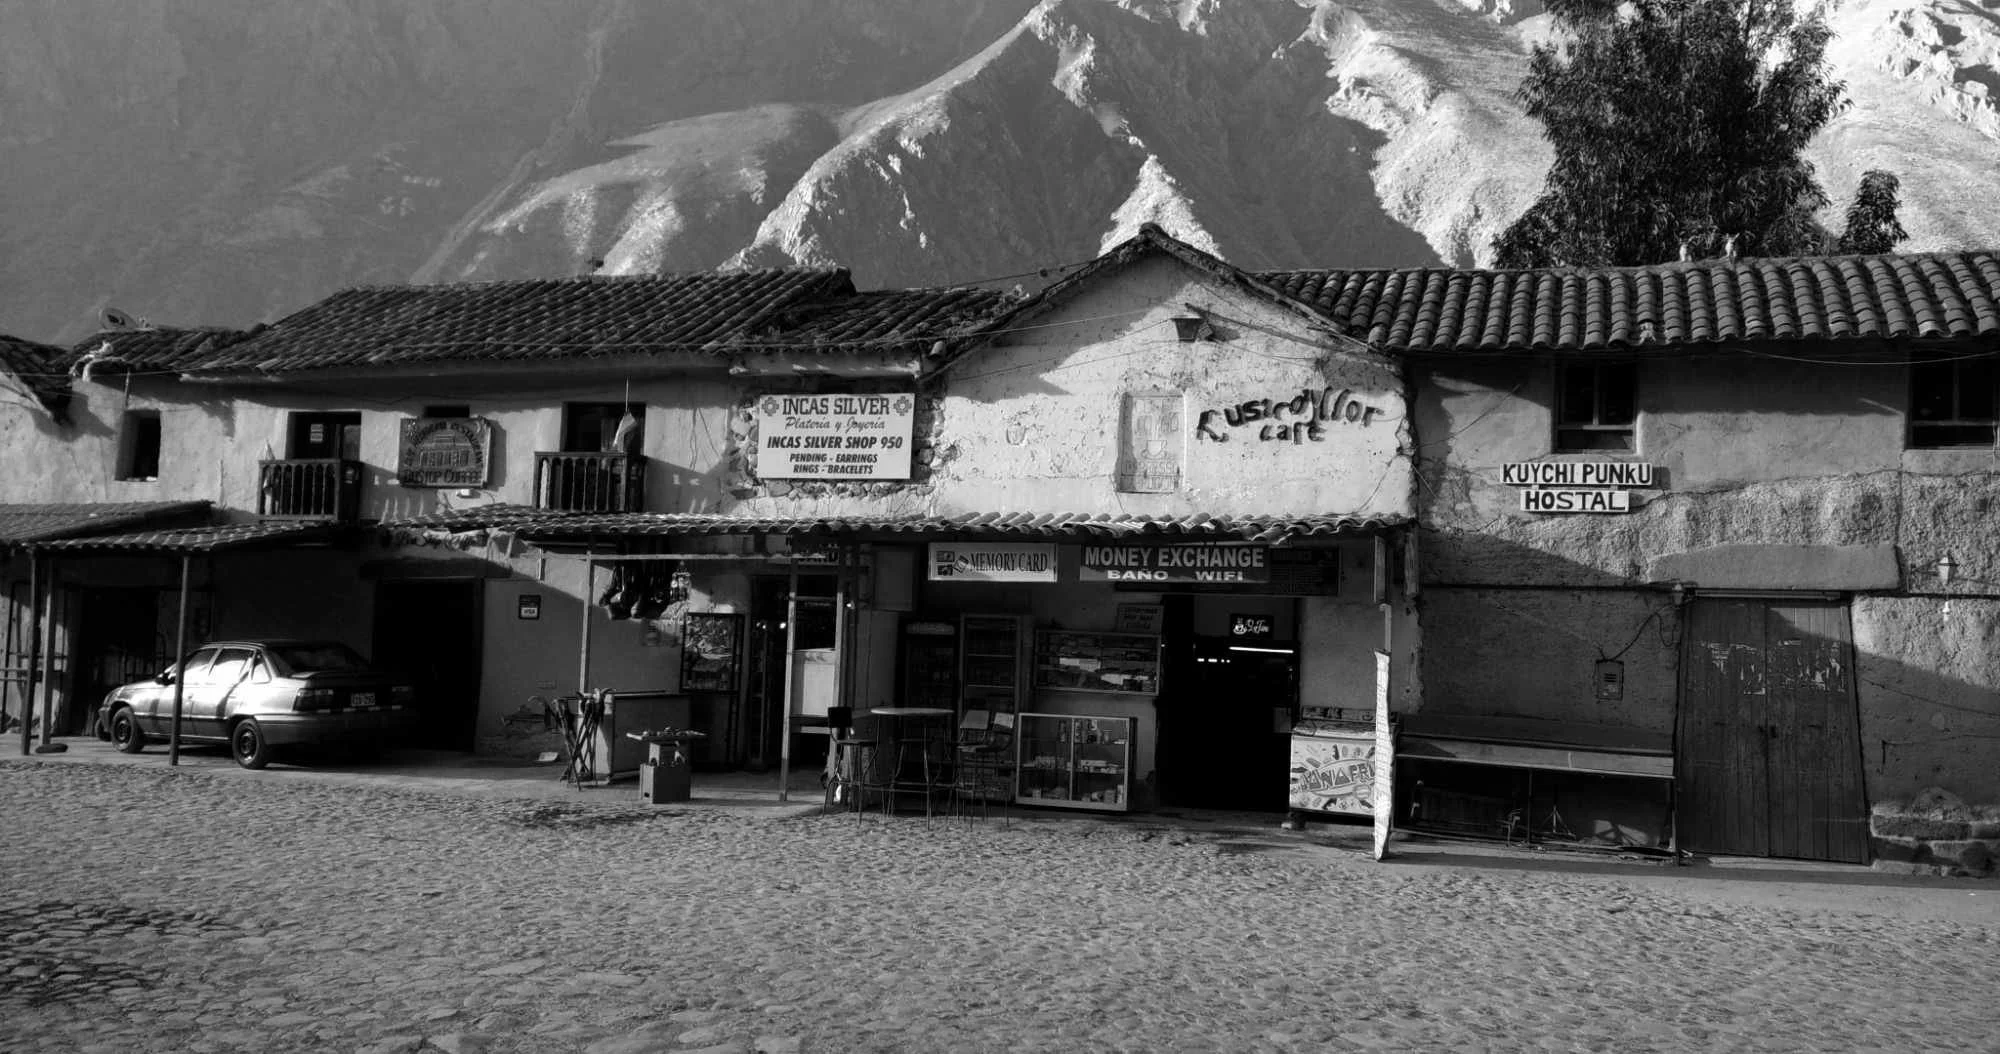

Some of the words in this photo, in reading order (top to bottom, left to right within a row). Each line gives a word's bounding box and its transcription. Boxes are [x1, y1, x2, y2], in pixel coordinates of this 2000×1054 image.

[782, 397, 829, 415] INCAS
[833, 397, 890, 415] SILVER
[834, 421, 843, 433] y
[767, 436, 801, 449] INCAS
[804, 436, 842, 449] SILVER
[845, 436, 877, 449] SHOP
[881, 436, 903, 449] 950
[790, 453, 827, 463] PENDING
[835, 453, 878, 463] EARRINGS
[793, 464, 819, 474] RINGS
[827, 465, 873, 474] BRACELETS
[1503, 464, 1576, 483] KUYCHI
[1525, 490, 1626, 510] HOSTAL
[970, 552, 1017, 572] MEMORY
[1018, 552, 1048, 572] CARD
[1085, 546, 1152, 567] MONEY
[1158, 547, 1264, 568] EXCHANGE
[1107, 568, 1169, 581] BAÑO
[1195, 571, 1243, 581] WIFI
